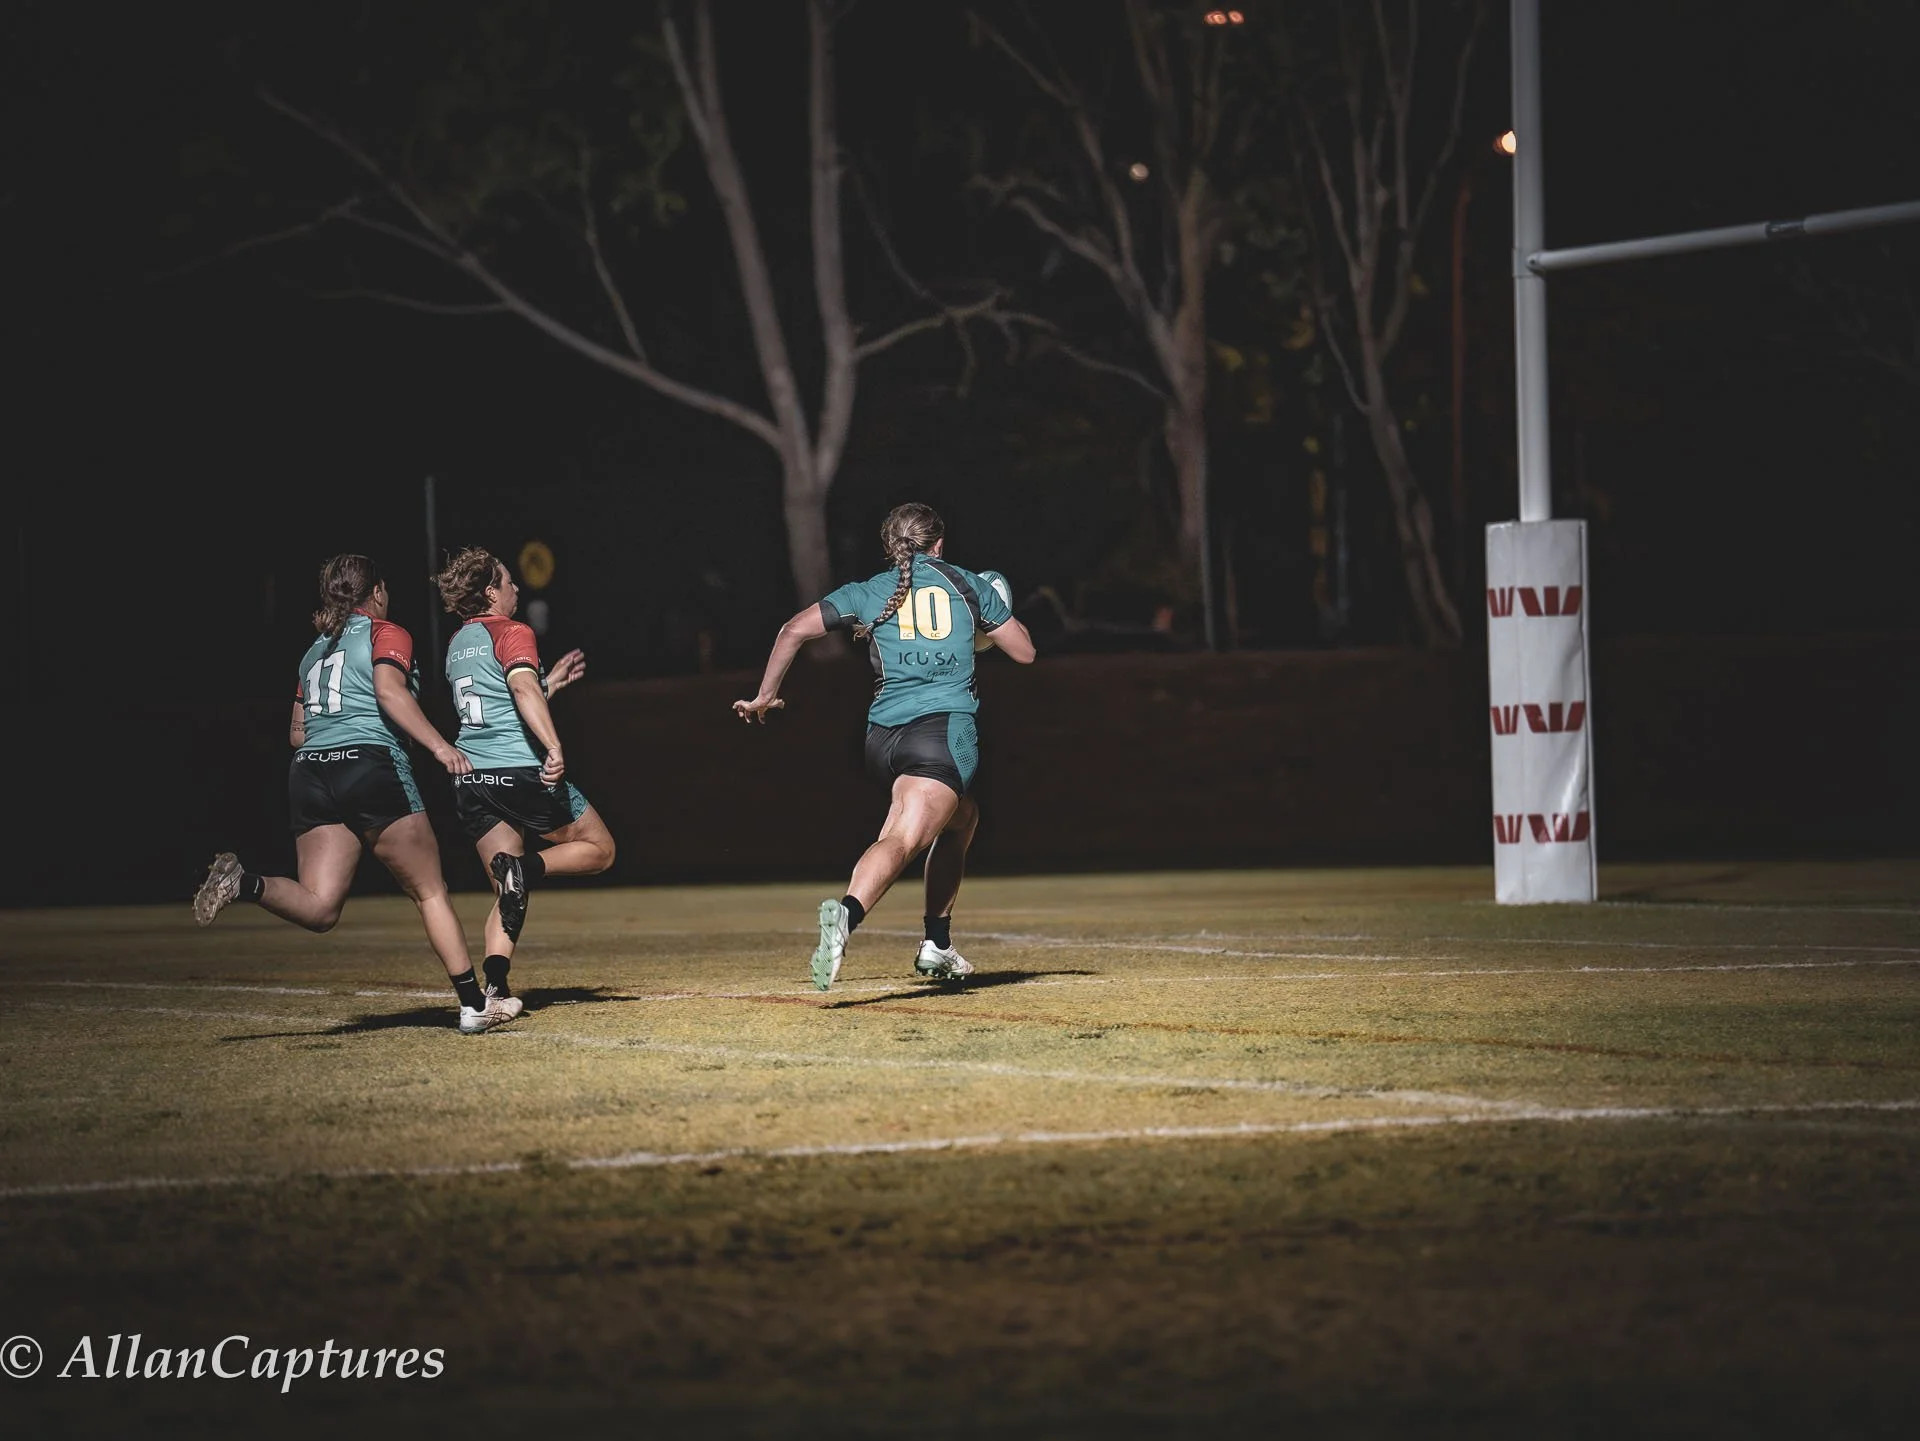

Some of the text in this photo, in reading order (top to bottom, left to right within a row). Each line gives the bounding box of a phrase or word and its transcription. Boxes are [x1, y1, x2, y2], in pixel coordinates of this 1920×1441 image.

[896, 585, 953, 641] 10
[451, 645, 489, 662] CUBIC
[454, 674, 485, 730] 5
[307, 749, 359, 762] CUBIC
[461, 773, 514, 787] CUBIC
